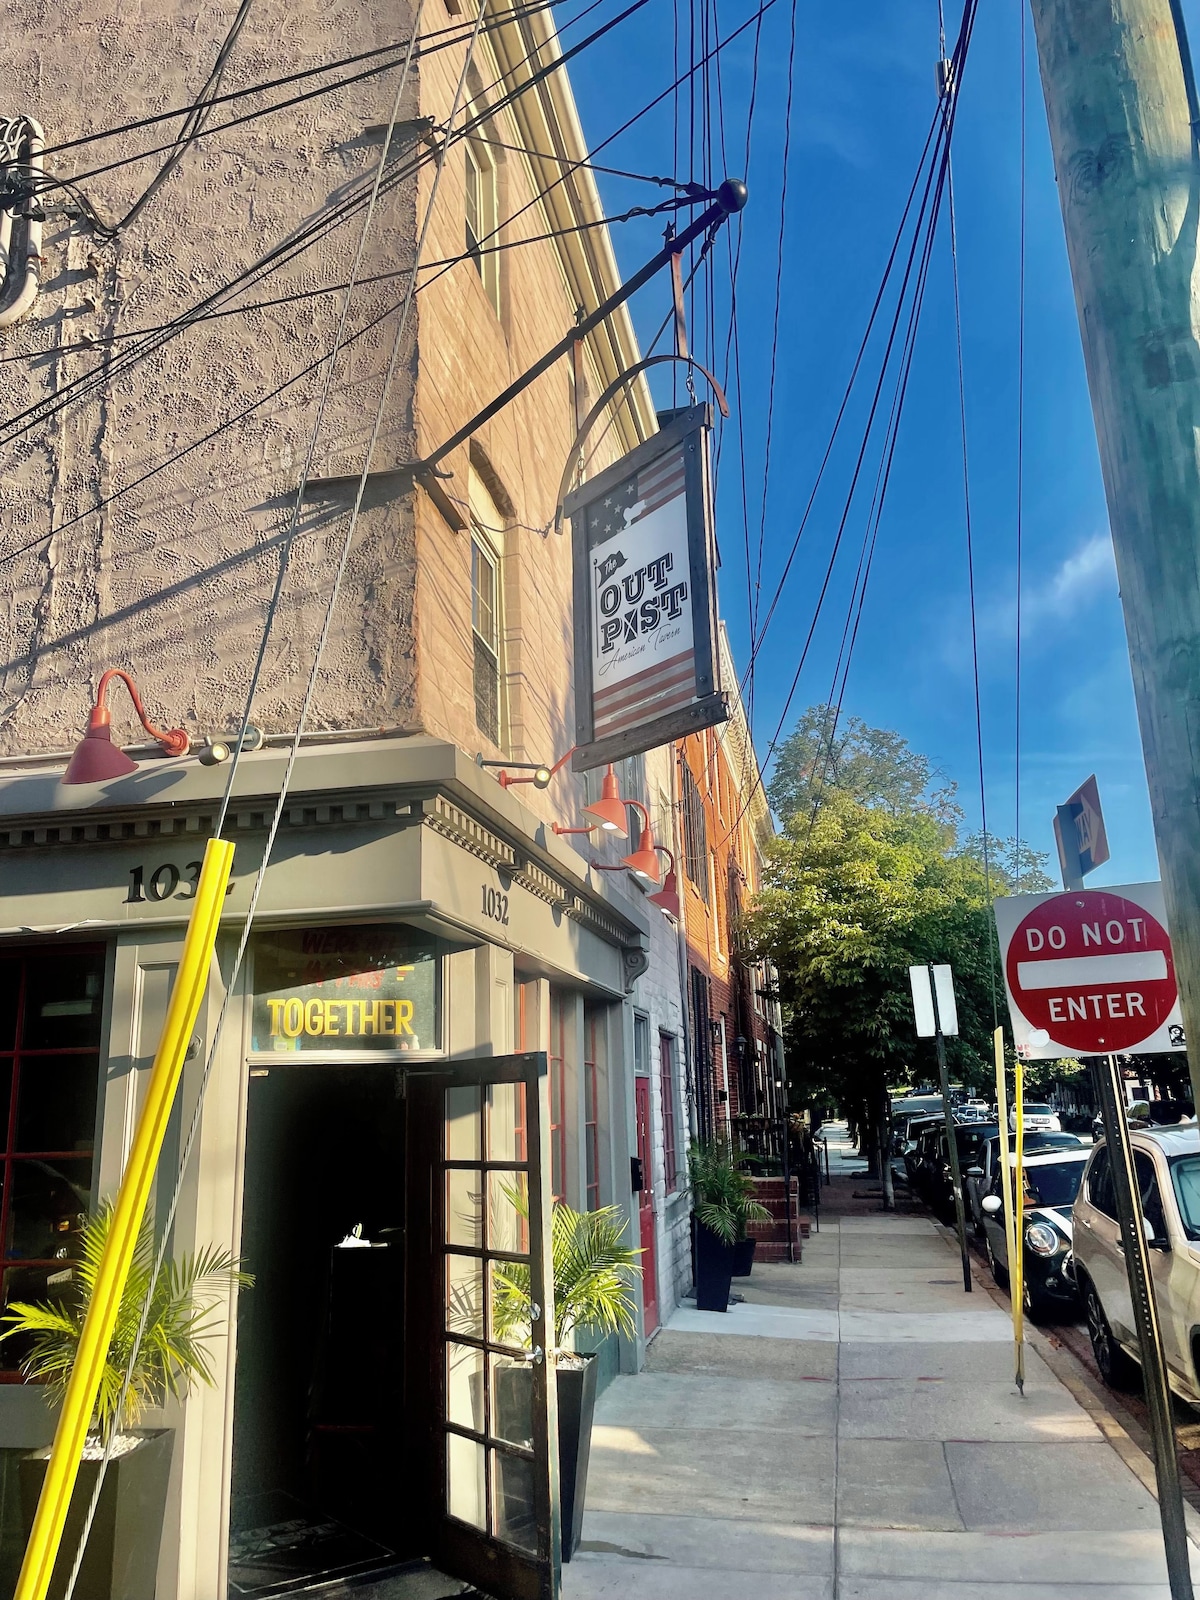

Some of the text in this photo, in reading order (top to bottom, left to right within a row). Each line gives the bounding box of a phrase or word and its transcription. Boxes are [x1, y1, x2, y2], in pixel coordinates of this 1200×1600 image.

[600, 552, 674, 618] OUT
[604, 558, 618, 576] The
[598, 623, 681, 677] American Tavern
[122, 861, 235, 904] 103
[481, 883, 510, 926] 1032
[1025, 918, 1143, 952] DO NOT
[266, 997, 415, 1037] TOGETHER
[1047, 992, 1147, 1023] ENTER
